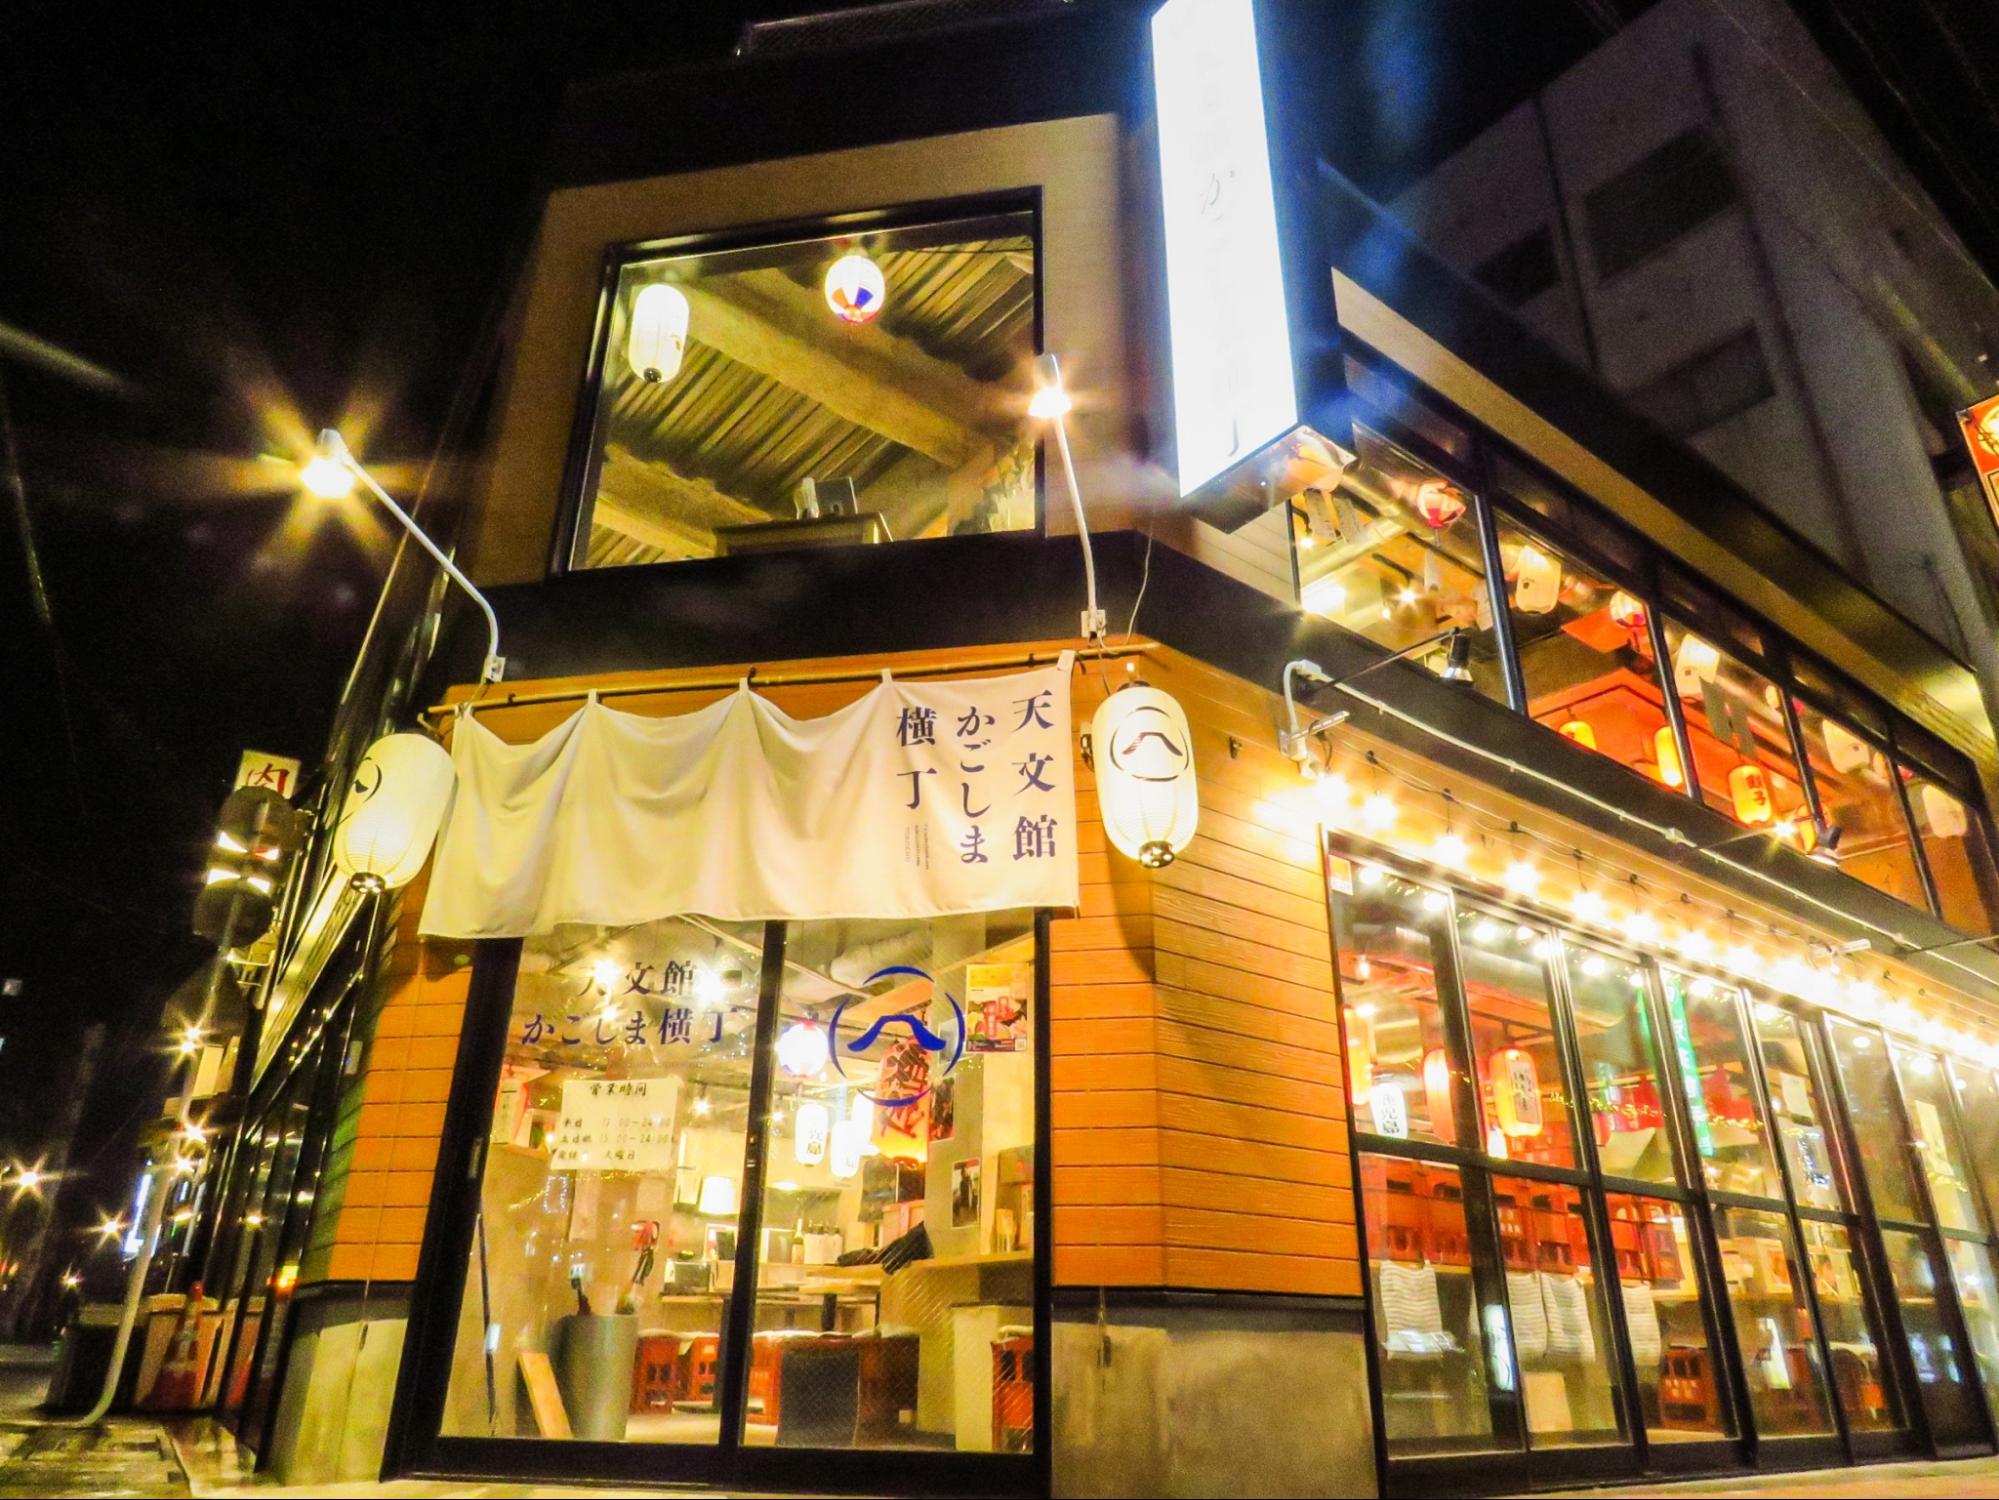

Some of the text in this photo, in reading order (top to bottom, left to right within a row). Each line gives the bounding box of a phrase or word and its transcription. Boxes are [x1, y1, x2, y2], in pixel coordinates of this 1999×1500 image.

[896, 706, 938, 810] 横丁
[957, 706, 996, 864] かごしま
[1012, 690, 1058, 861] 天文館
[521, 1007, 738, 1045] かごしま横丁
